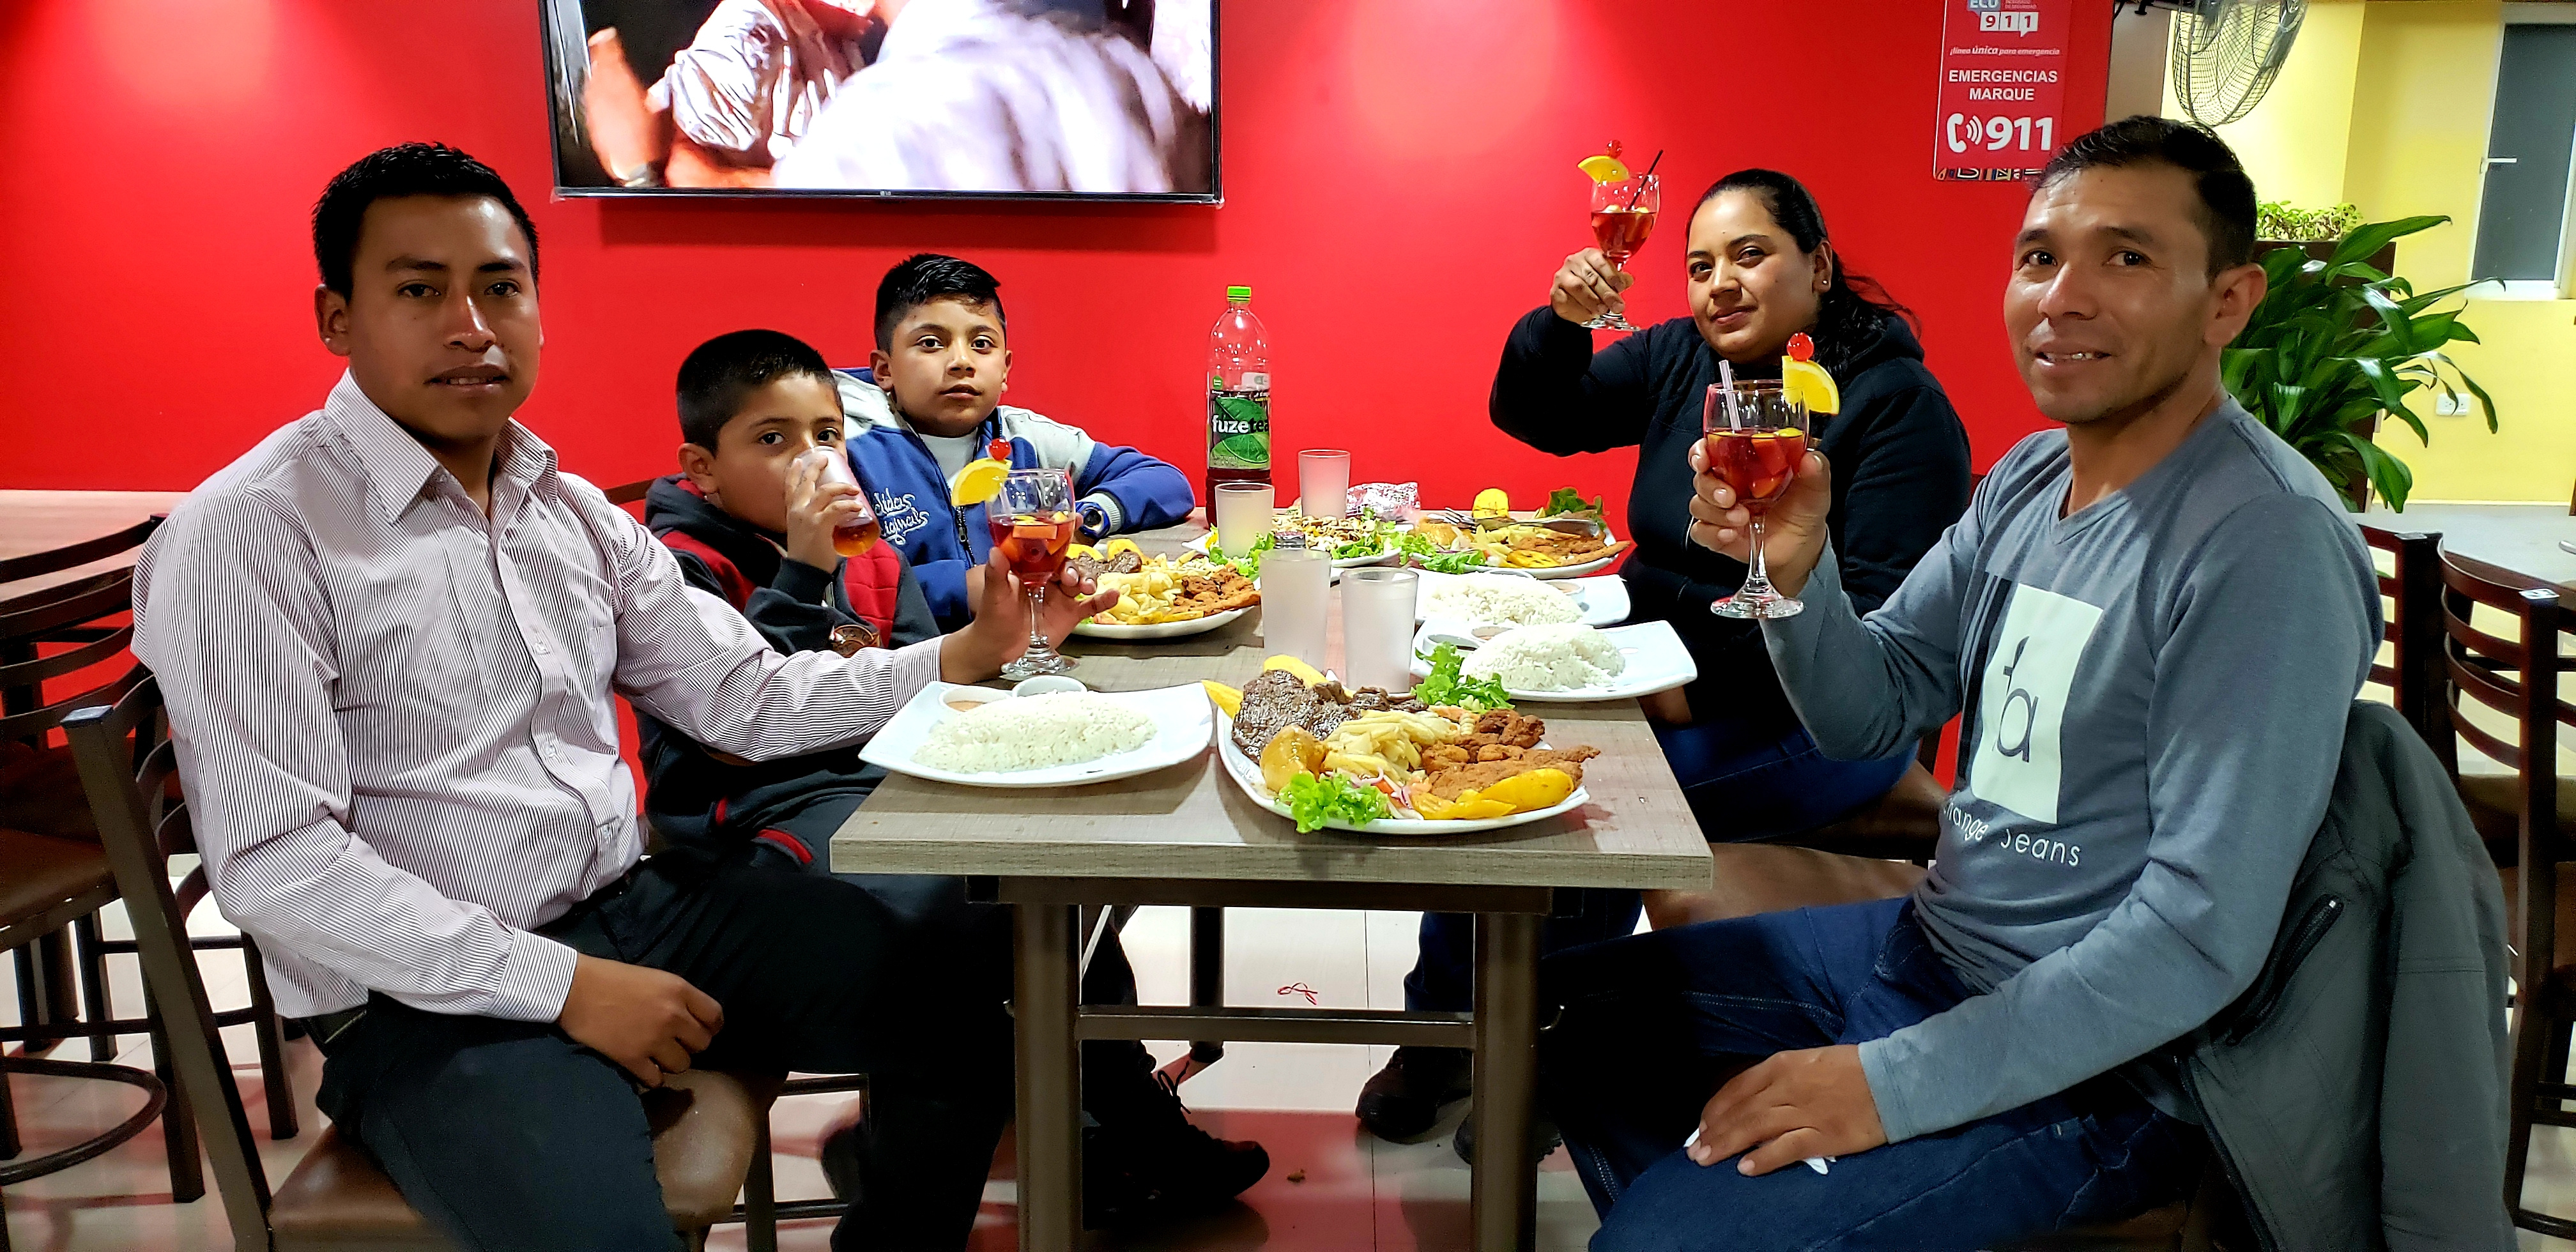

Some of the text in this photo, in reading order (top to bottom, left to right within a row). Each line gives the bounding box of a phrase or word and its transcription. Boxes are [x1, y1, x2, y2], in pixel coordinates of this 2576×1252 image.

[1985, 15, 2031, 28] 911
[1949, 70, 2058, 83] EMERGENCIAS
[1969, 88, 2035, 101] MARQUE
[1986, 116, 2053, 151] 911
